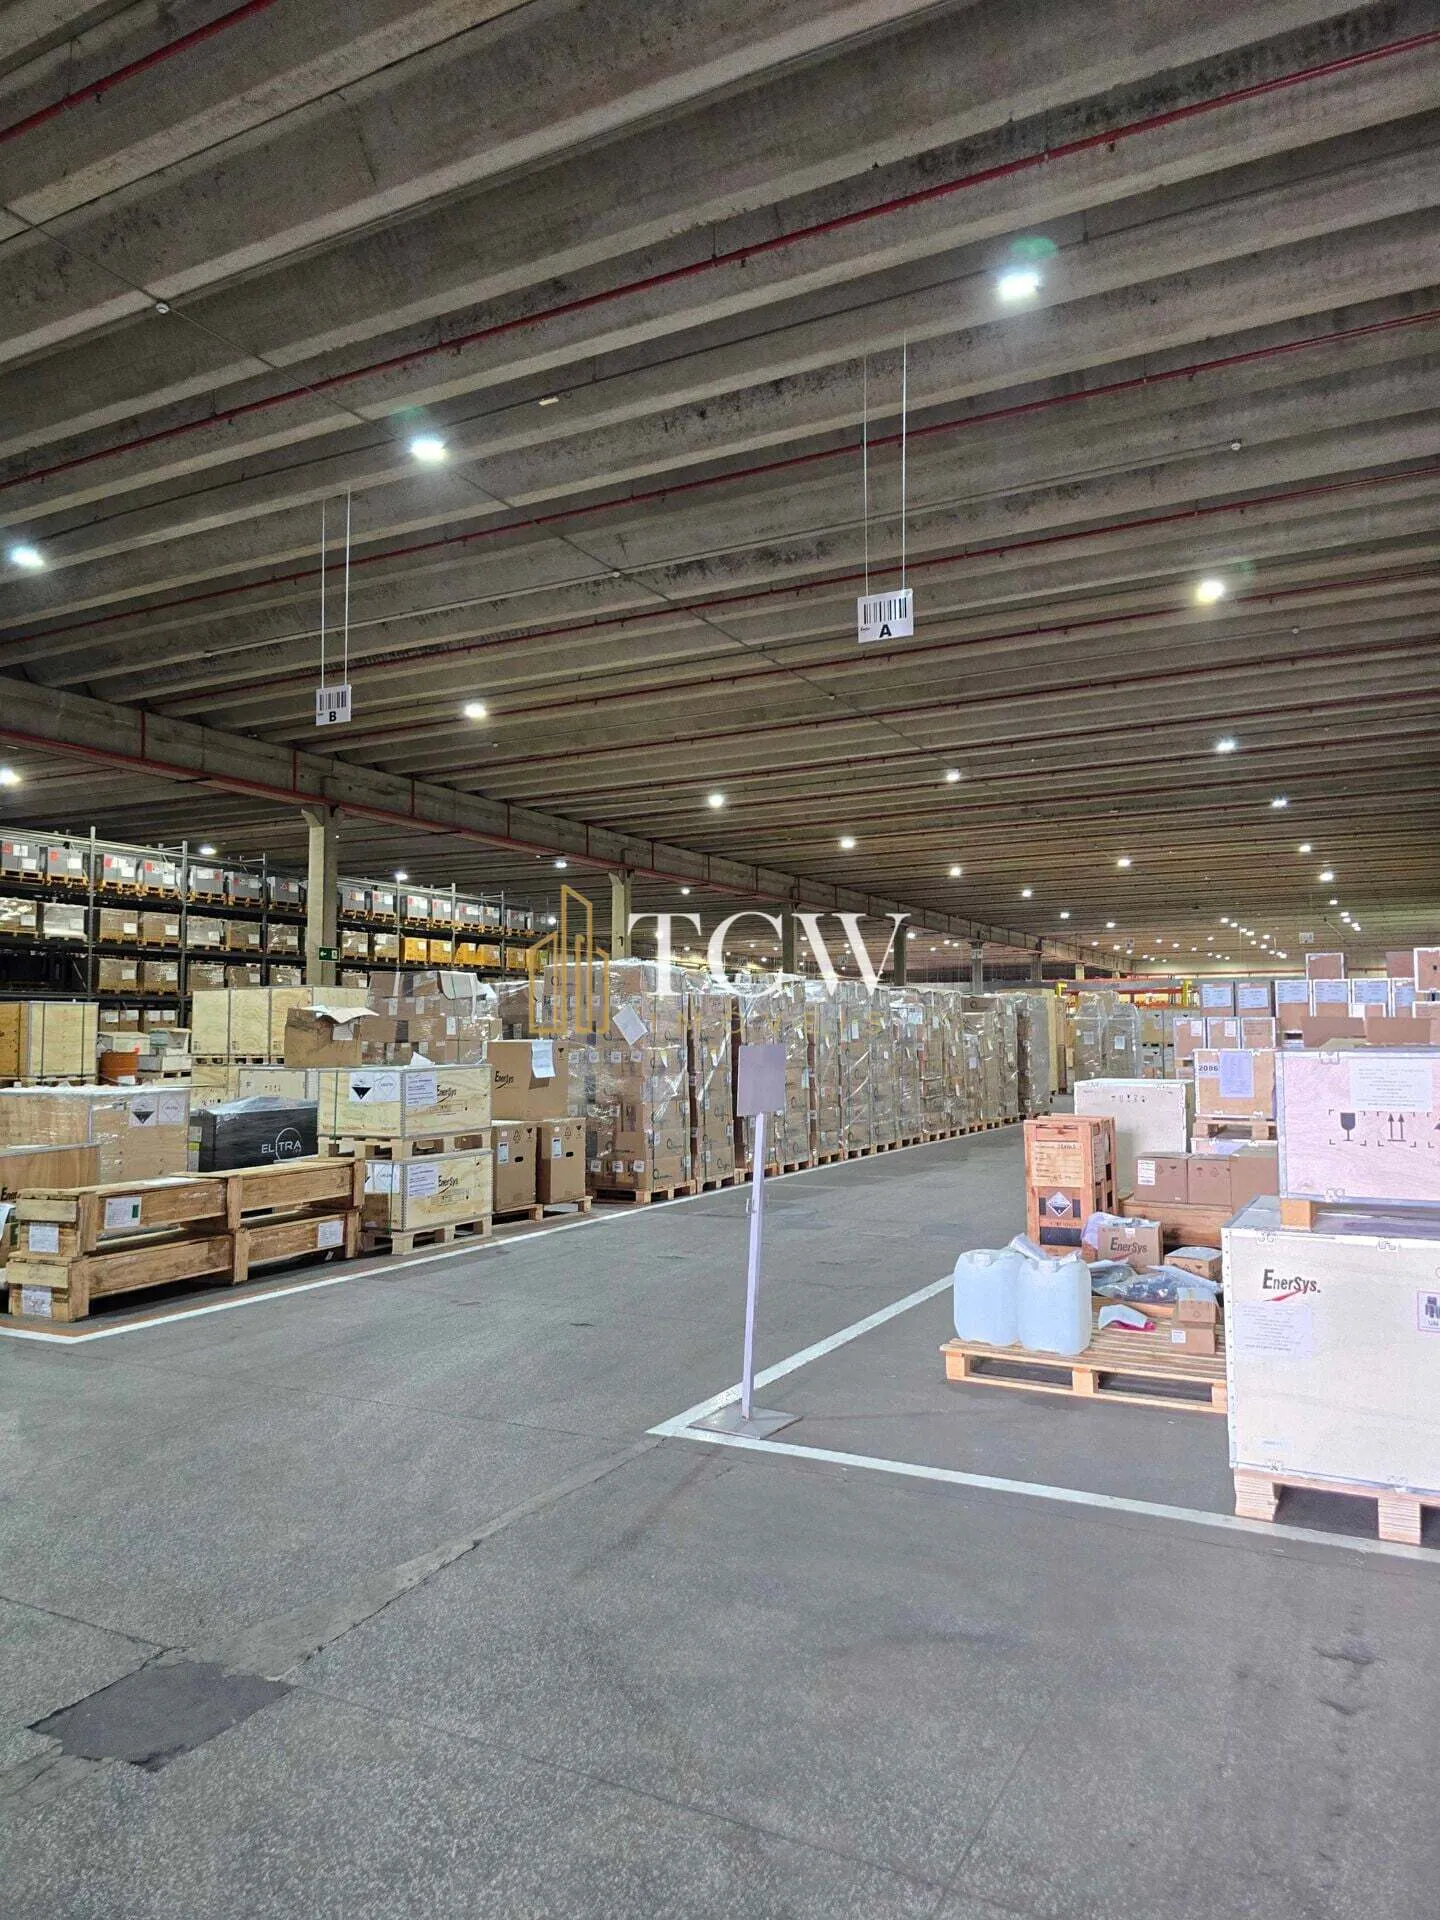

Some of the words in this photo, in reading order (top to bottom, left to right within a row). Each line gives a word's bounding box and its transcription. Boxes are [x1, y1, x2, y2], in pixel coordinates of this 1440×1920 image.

[879, 624, 892, 638] A
[328, 711, 337, 722] B
[261, 1140, 302, 1154] ELTRA
[1110, 1237, 1148, 1254] EnerSys
